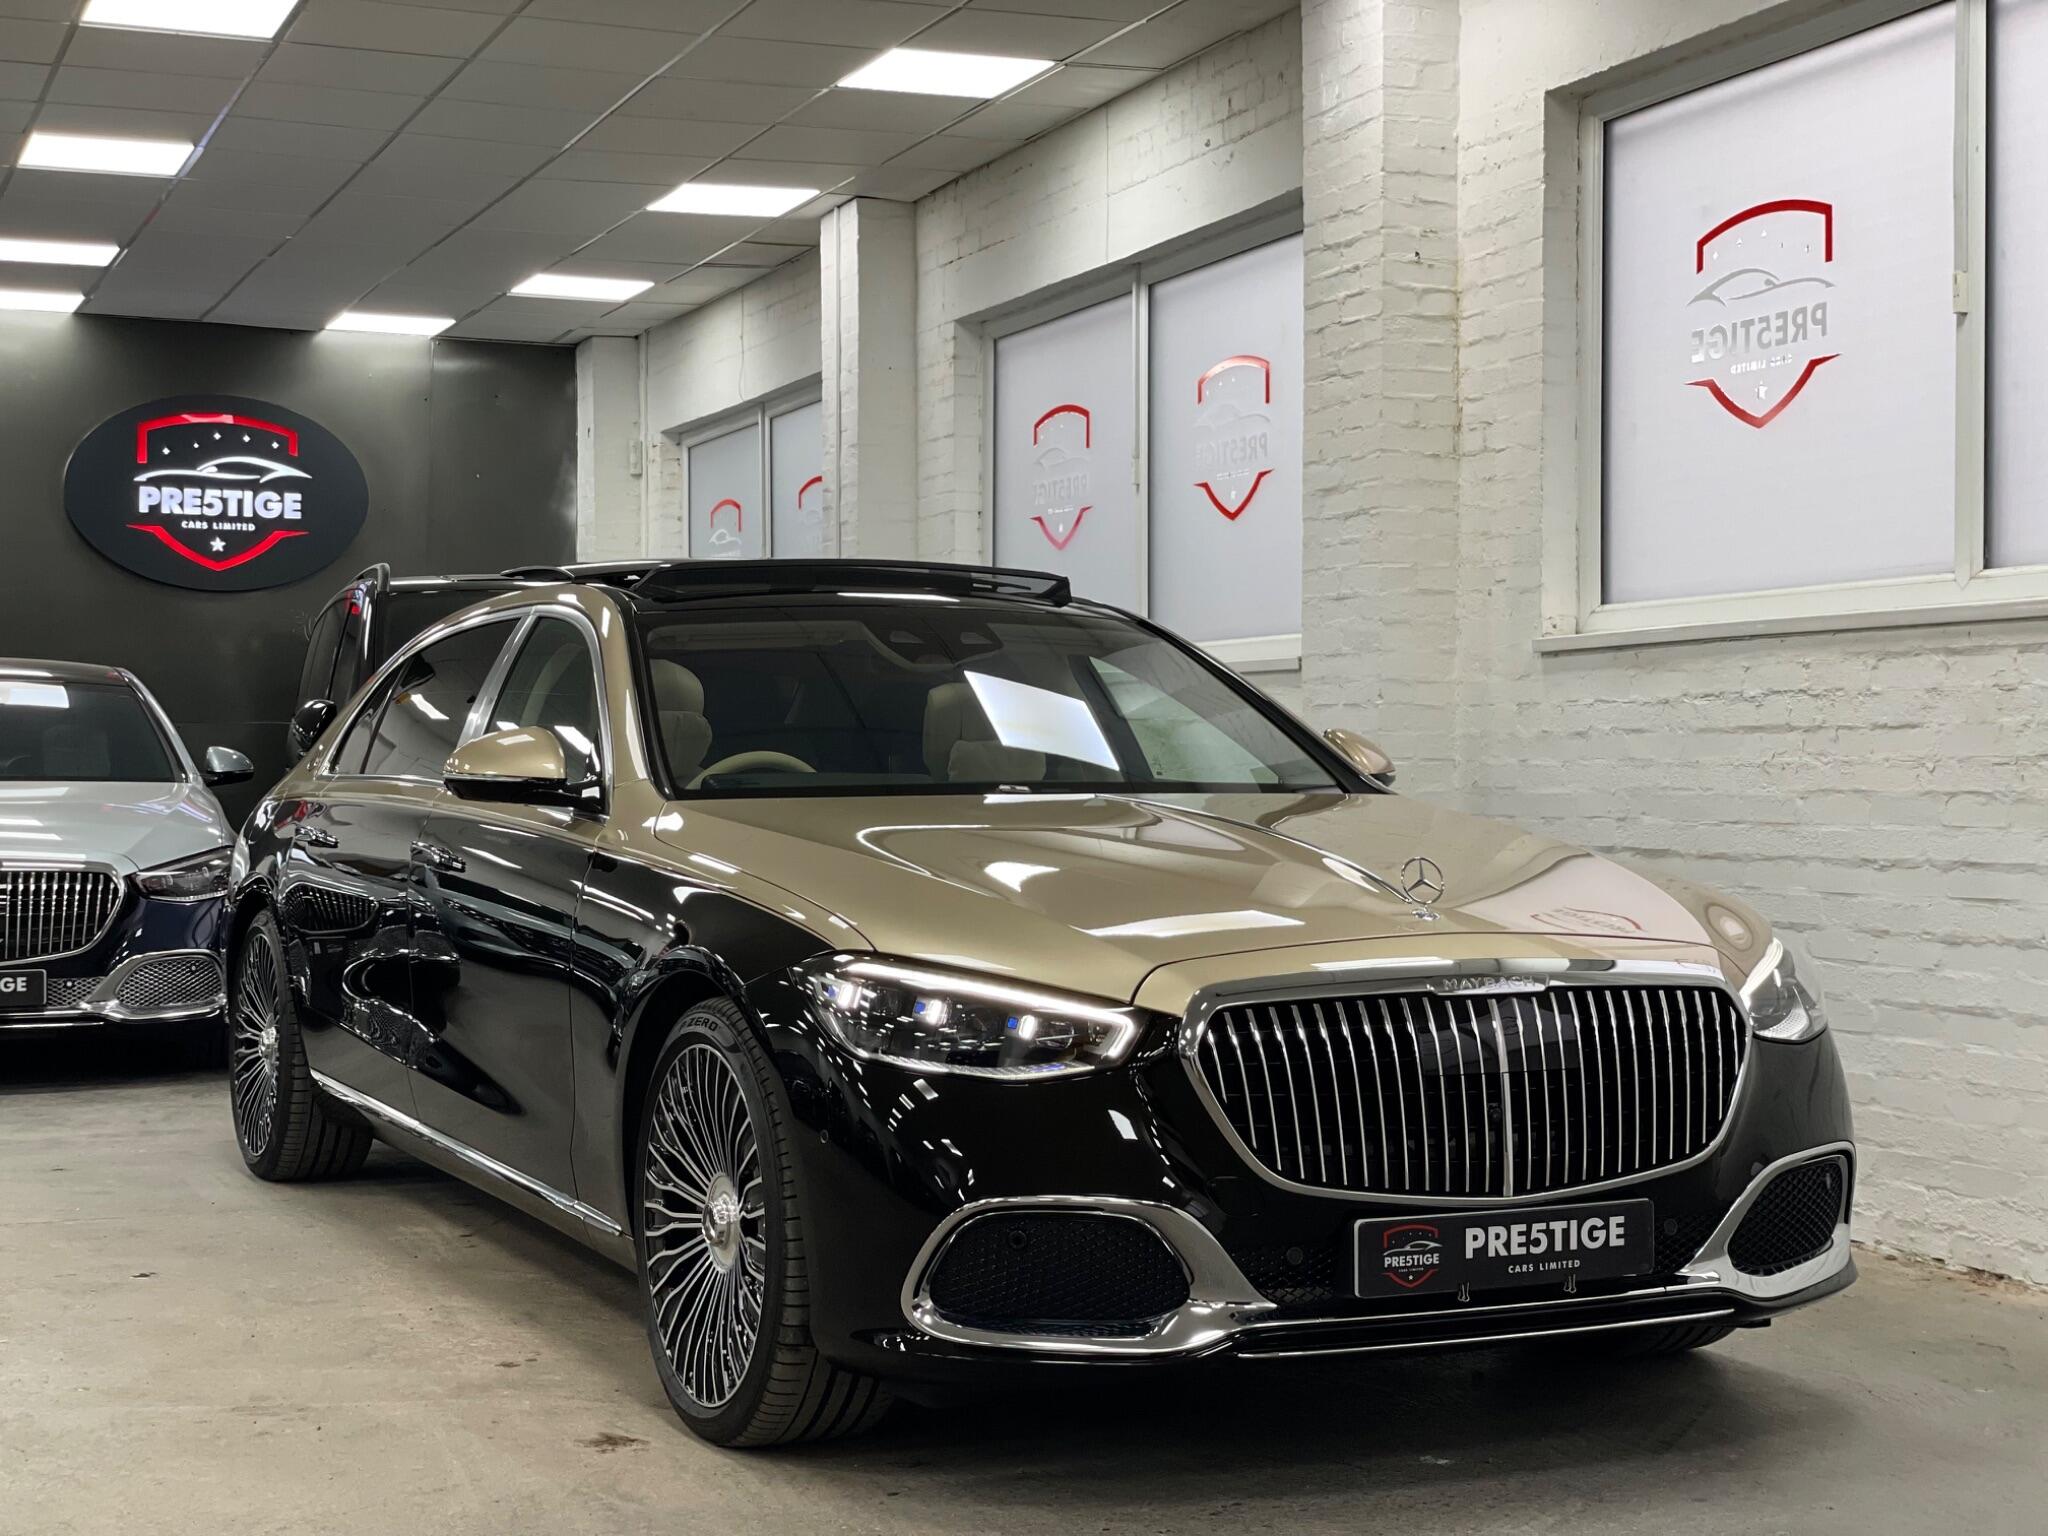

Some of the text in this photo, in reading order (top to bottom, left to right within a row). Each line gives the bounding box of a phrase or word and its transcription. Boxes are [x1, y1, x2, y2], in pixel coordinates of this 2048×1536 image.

[138, 486, 302, 520] PRE5TIGE
[181, 521, 256, 532] CARS LIMITED
[1442, 975, 1536, 991] MAYBACH
[687, 1016, 719, 1032] ZERO
[1465, 1215, 1625, 1260] PRE5TIGE
[1384, 1253, 1440, 1268] PRE5TIGE
[1508, 1259, 1581, 1274] CARS LIMITED
